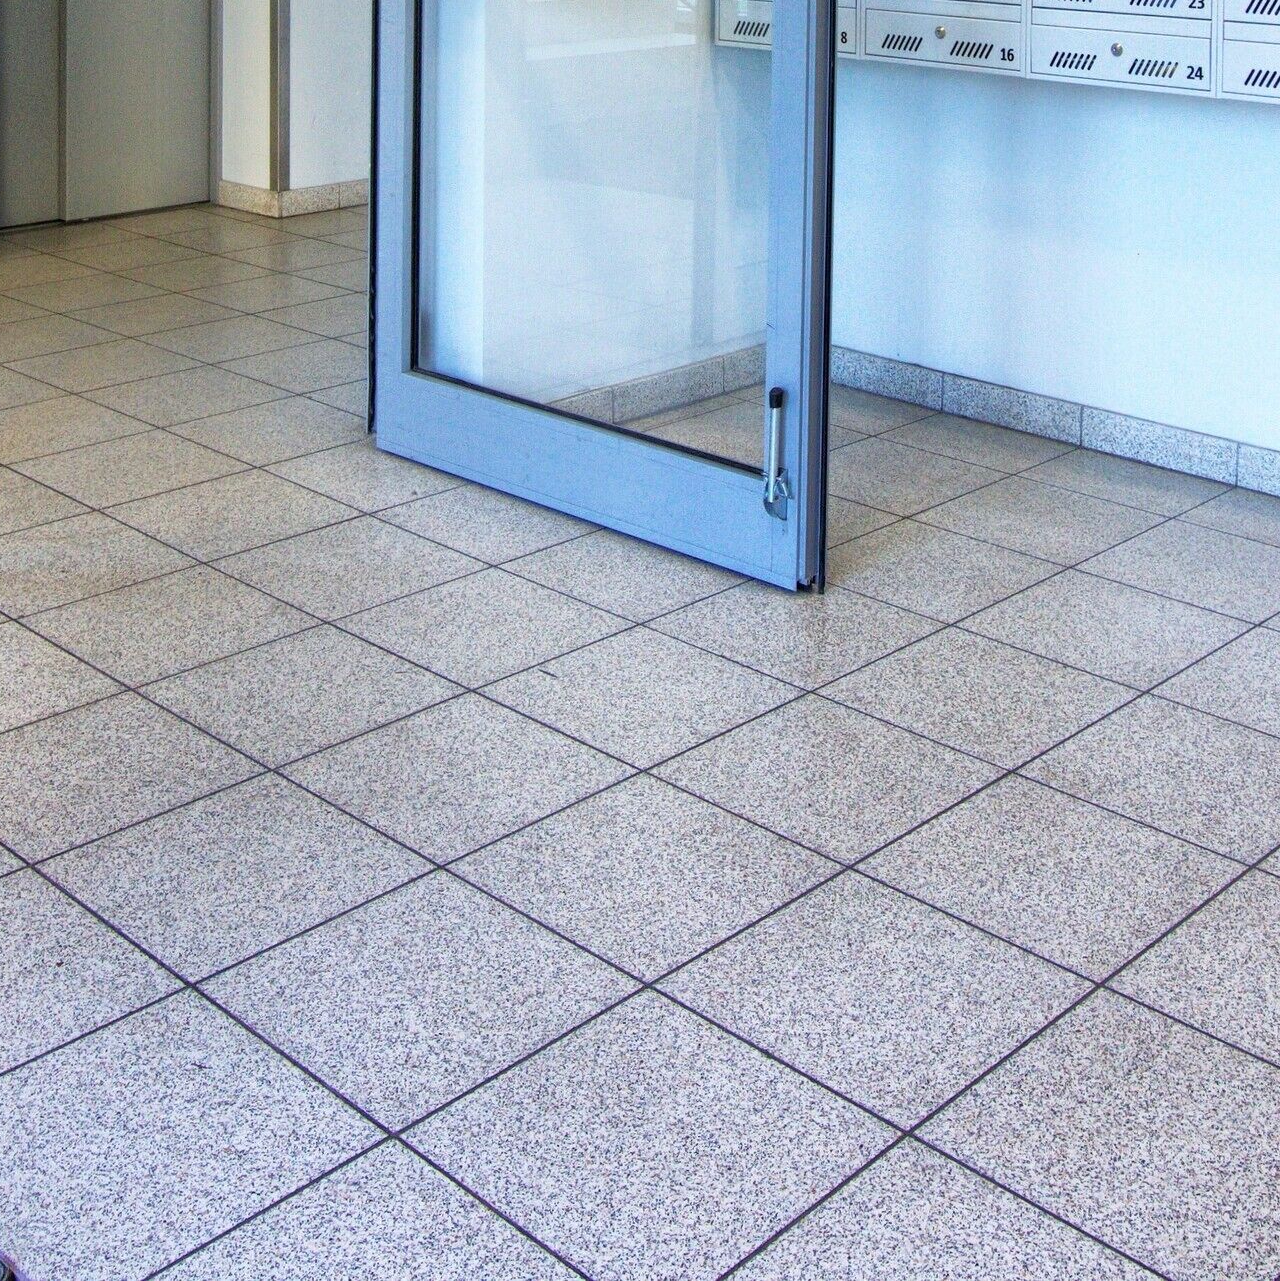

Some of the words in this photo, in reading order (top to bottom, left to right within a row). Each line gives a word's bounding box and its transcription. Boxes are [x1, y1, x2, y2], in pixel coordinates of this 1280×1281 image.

[840, 31, 848, 44] 8
[1000, 47, 1015, 62] 16
[1186, 65, 1204, 81] 24
